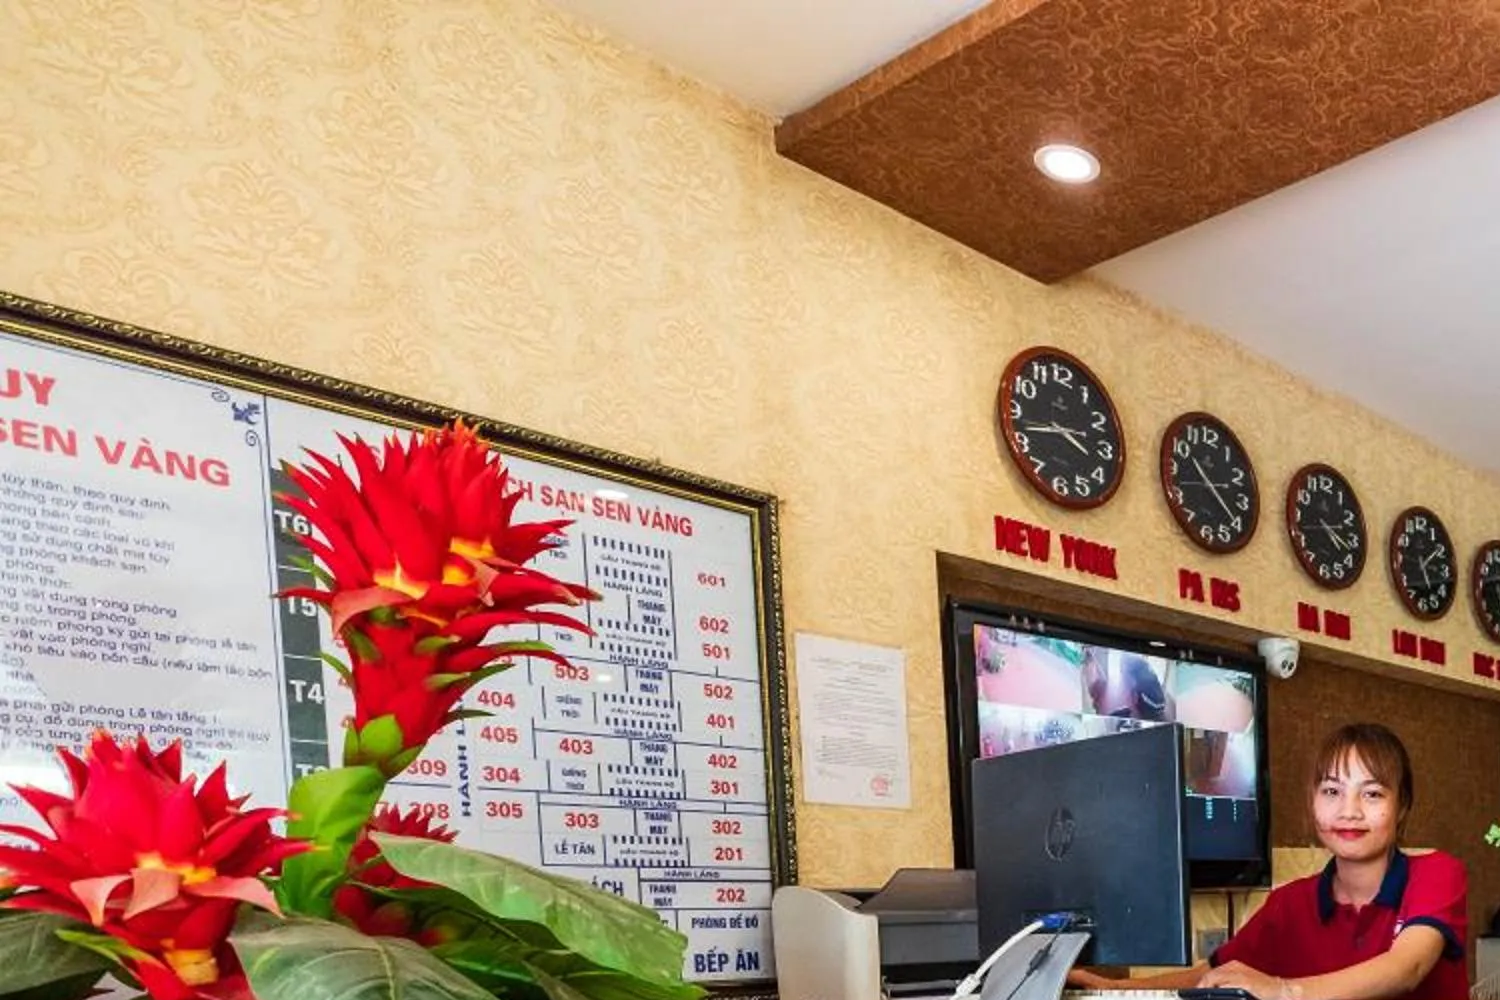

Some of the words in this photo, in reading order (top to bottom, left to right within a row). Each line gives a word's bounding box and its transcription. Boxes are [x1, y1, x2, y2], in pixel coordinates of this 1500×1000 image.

[1032, 361, 1047, 384] 11
[1050, 363, 1073, 389] 12
[1015, 375, 1037, 399] 10
[1080, 385, 1089, 404] 1
[1091, 411, 1106, 432] 2
[1186, 425, 1198, 444] 11
[1202, 426, 1219, 448] 12
[0, 417, 78, 457] EN
[95, 435, 231, 487] VÀNG
[1097, 441, 1113, 460] 3
[1172, 436, 1190, 459] 10
[1224, 445, 1230, 462] 1
[1029, 456, 1045, 474] 7
[1091, 466, 1105, 484] 4
[1231, 467, 1245, 486] 2
[1052, 475, 1068, 496] 6
[1075, 474, 1090, 496] 5
[1236, 493, 1249, 511] 3
[1337, 491, 1343, 505] 1
[274, 510, 310, 536] T6
[592, 496, 631, 523] SEN
[637, 506, 693, 537] VÀNG
[1183, 507, 1195, 522] 7
[1343, 509, 1355, 526] 2
[1218, 524, 1231, 542] 5
[1230, 516, 1242, 532] 4
[1348, 533, 1359, 548] 3
[1343, 554, 1353, 568] 4
[1333, 562, 1344, 579] 5
[698, 573, 725, 587] 601
[699, 616, 729, 634] 602
[702, 643, 731, 660] 501
[555, 663, 589, 681] 503
[289, 679, 324, 704] T4
[477, 690, 515, 709] 404
[704, 683, 733, 700] 502
[706, 713, 735, 729] 401
[480, 726, 518, 744] 405
[560, 738, 593, 755] 403
[407, 759, 446, 777] 309
[708, 754, 737, 769] 402
[483, 766, 521, 783] 304
[711, 781, 738, 795] 301
[486, 801, 523, 818] 305
[565, 813, 599, 829] 303
[712, 819, 741, 835] 302
[715, 847, 743, 861] 201
[716, 888, 745, 903] 202
[693, 946, 729, 973] BẾP
